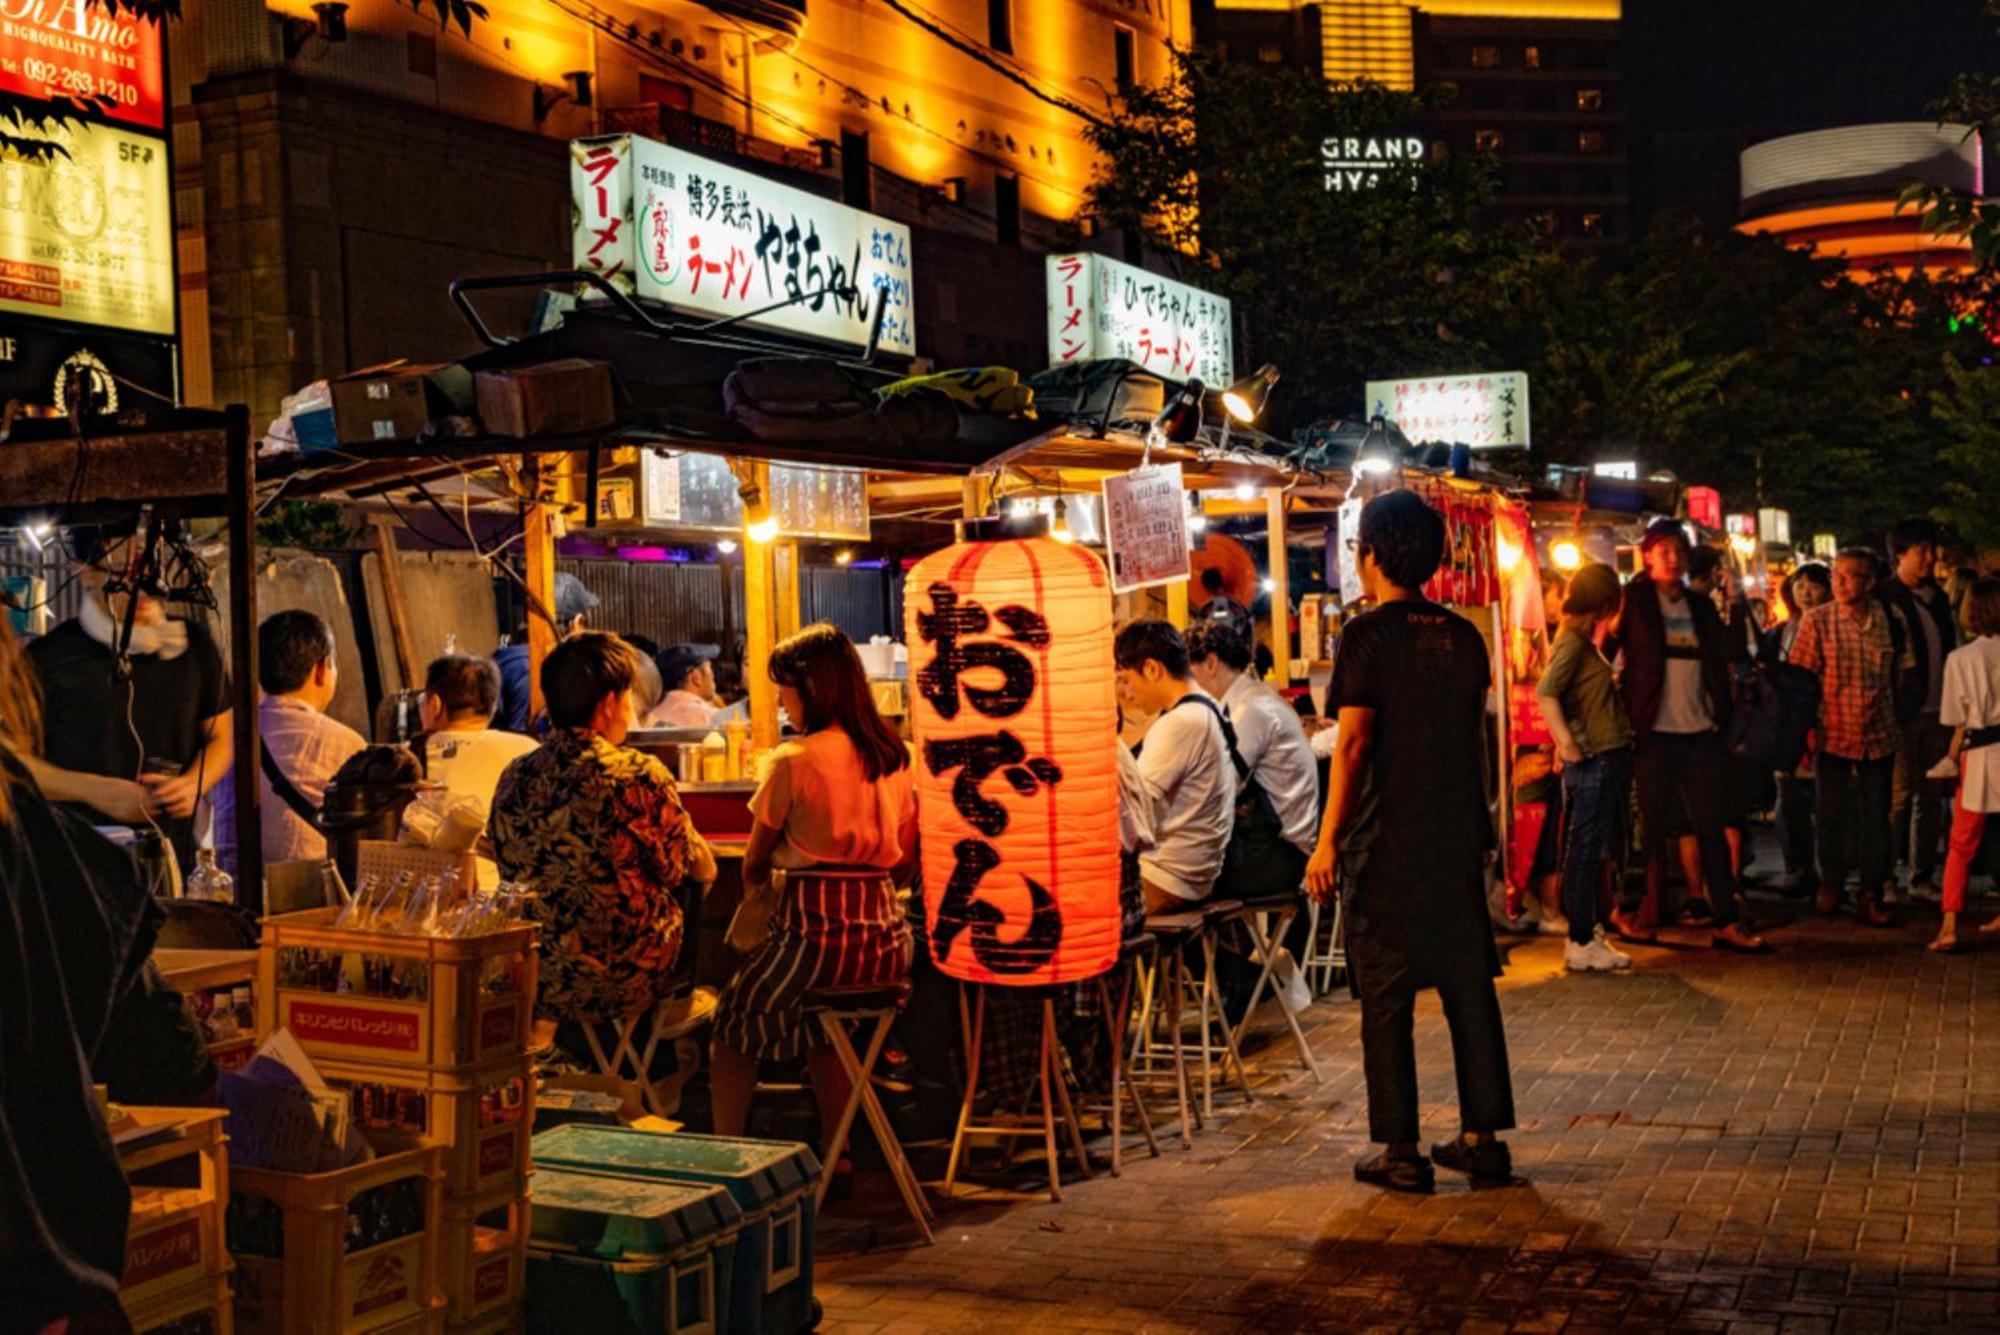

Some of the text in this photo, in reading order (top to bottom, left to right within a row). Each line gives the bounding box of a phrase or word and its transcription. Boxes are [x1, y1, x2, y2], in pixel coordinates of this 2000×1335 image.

[2, 21, 137, 70] HIGHQUALITY BATH
[23, 56, 138, 106] 092-263-1210
[118, 141, 141, 163] 5F
[1320, 137, 1424, 159] GRAND
[584, 146, 624, 288] ラーメン
[687, 234, 754, 301] ラーメン
[754, 206, 869, 323] やまちゃん
[871, 226, 908, 269] おでん
[1056, 255, 1088, 362] ラーメン
[1123, 275, 1196, 330] ひでちゃん
[1137, 327, 1197, 376] ラーメン
[915, 578, 1064, 977] おでん
